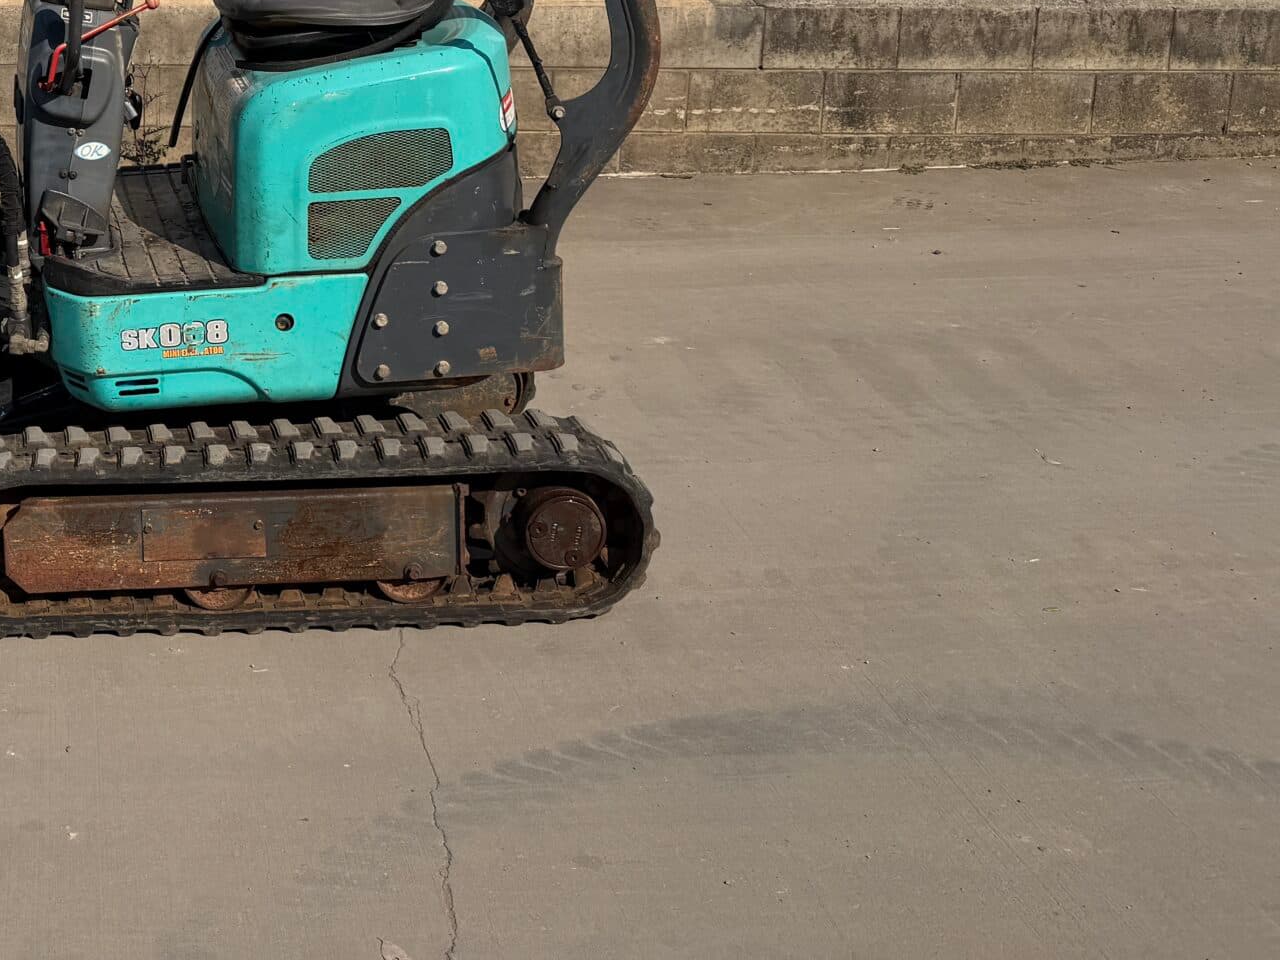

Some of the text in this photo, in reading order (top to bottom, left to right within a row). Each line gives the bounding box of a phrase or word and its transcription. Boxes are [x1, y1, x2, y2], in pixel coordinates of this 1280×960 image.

[81, 145, 103, 157] OK
[162, 346, 224, 359] MINI ECATOR
